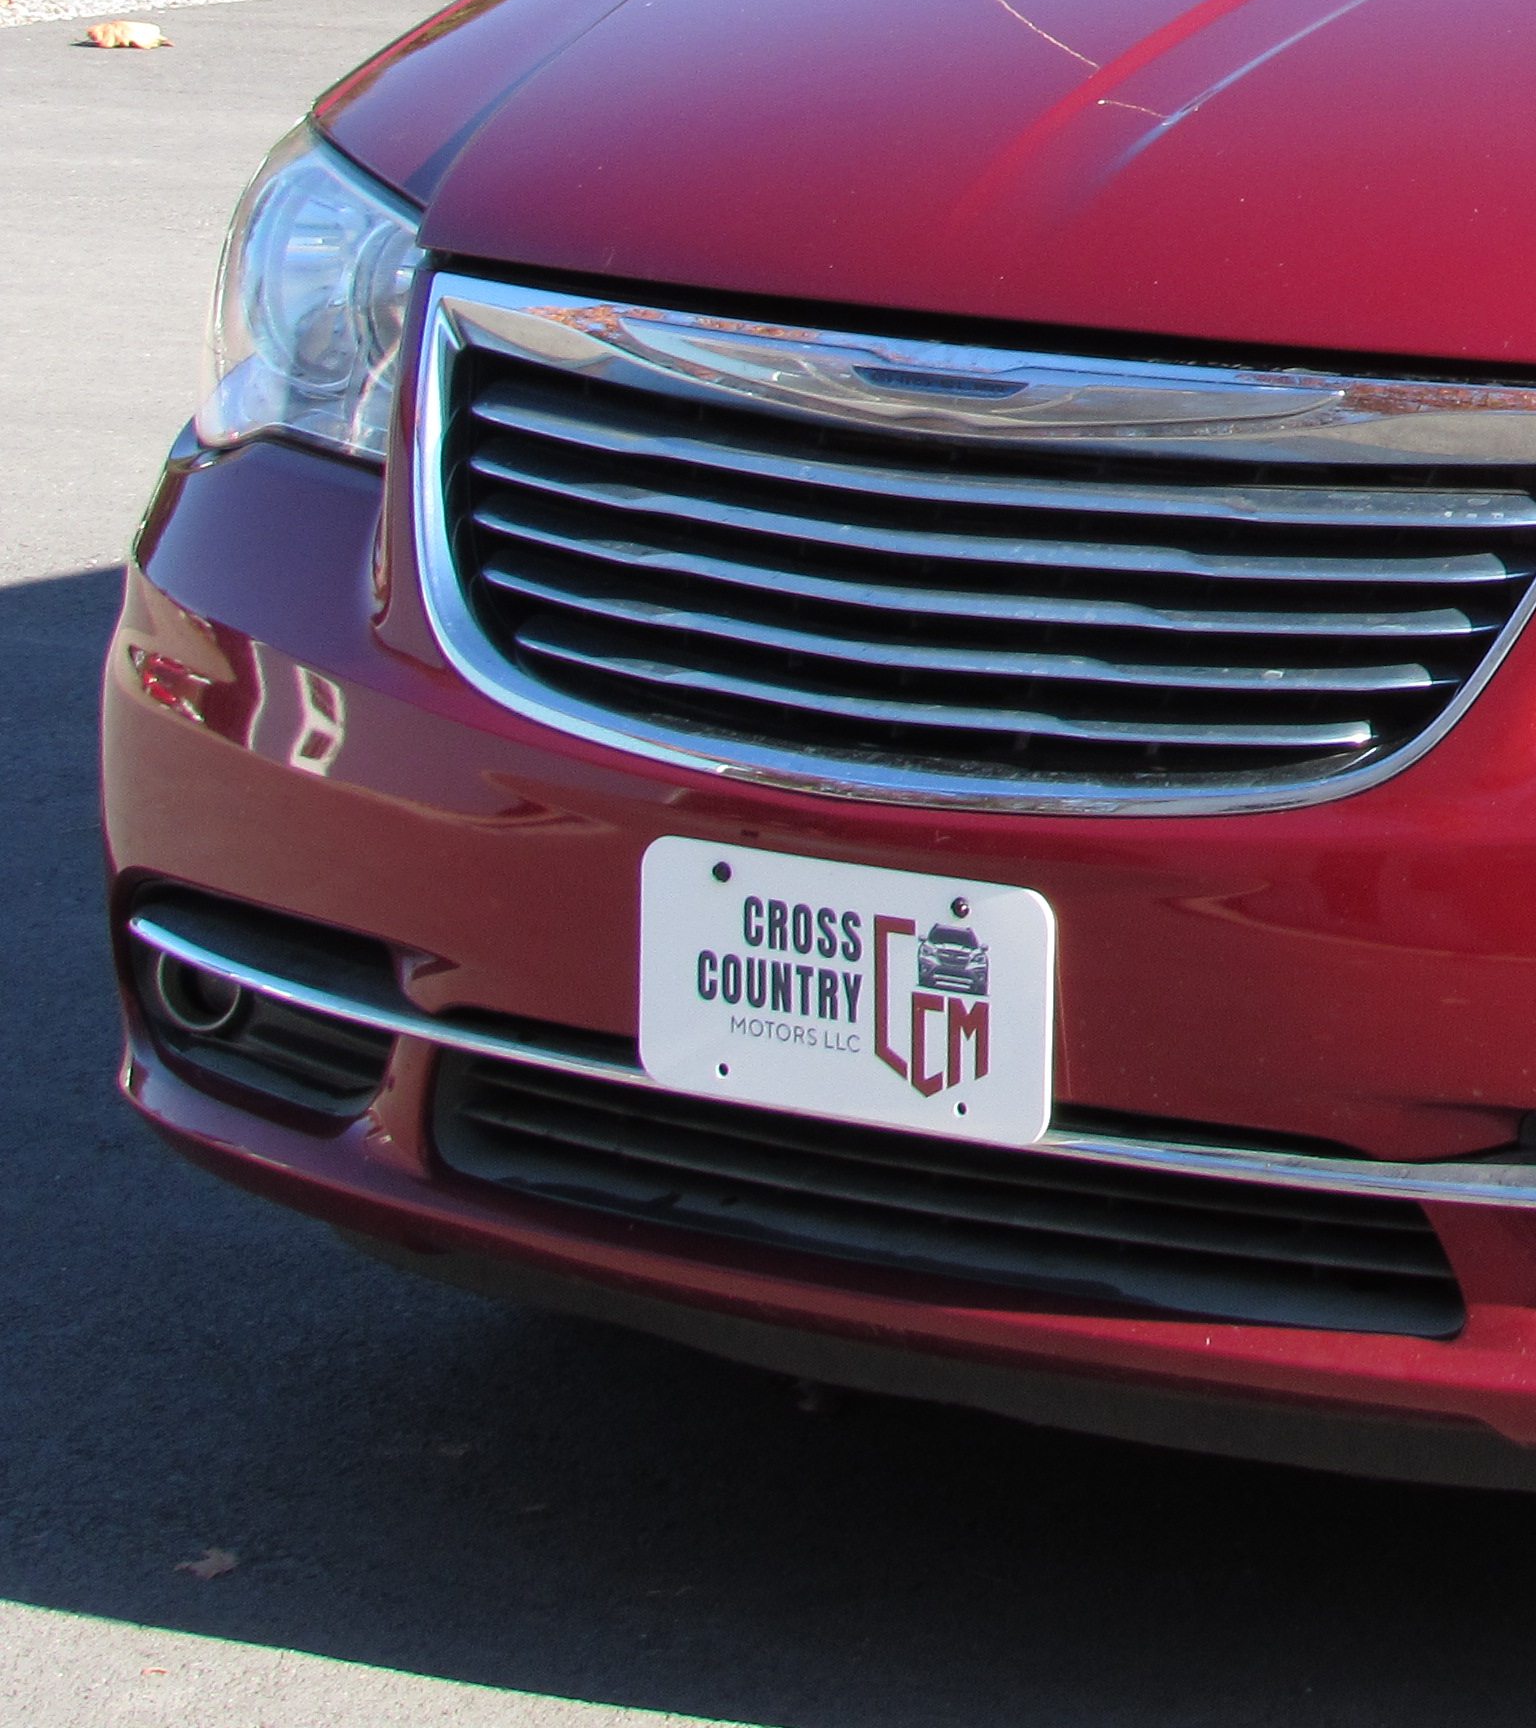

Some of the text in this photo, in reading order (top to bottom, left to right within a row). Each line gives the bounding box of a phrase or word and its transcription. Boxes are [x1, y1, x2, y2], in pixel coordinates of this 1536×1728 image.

[743, 895, 863, 962] CROSS
[698, 949, 864, 1024] COUNTRY
[730, 1015, 861, 1053] MOTORS LLC
